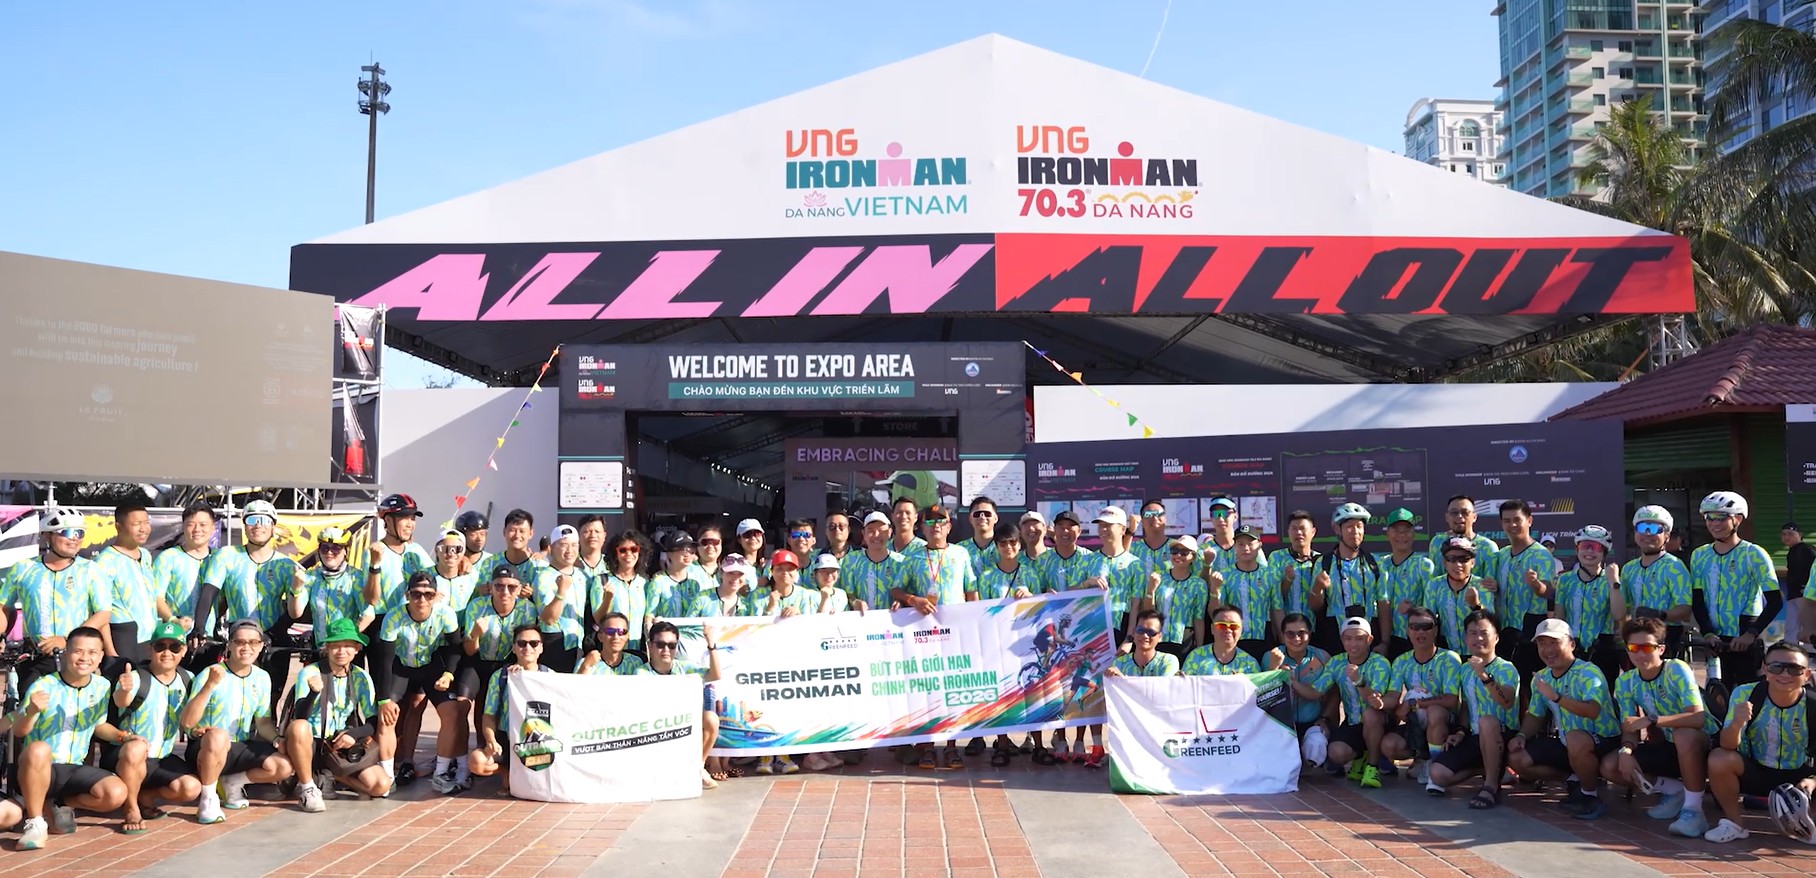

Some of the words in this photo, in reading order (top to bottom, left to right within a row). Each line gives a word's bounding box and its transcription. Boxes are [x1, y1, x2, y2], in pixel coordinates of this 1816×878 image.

[786, 128, 858, 158] VNG
[1017, 125, 1089, 154] VNG
[786, 142, 967, 189] IRONMAN
[1017, 141, 1198, 187] IRONMAN
[785, 208, 803, 218] DA
[807, 207, 845, 218] NANG
[844, 195, 967, 216] VIETNAM
[1017, 188, 1087, 218] 70.3
[1093, 204, 1123, 218] DA
[1130, 204, 1193, 219] NANG
[335, 250, 724, 321] ALL
[740, 243, 995, 317] IN
[996, 245, 1336, 314] ALL
[1337, 246, 1674, 315] OUT
[73, 320, 98, 333] 2000
[100, 324, 136, 337] farmers
[136, 340, 178, 357] journey
[579, 355, 594, 363] VNG
[64, 350, 130, 367] sustainable
[133, 357, 193, 373] agriculture
[668, 355, 768, 379] WELCOME
[774, 355, 799, 378] TO
[805, 354, 855, 378] EXPO
[861, 354, 915, 377] AREA
[683, 384, 713, 396] CHÀO
[715, 384, 747, 396] MỪNG
[749, 386, 771, 398] BẠN
[773, 383, 795, 396] ĐẾN
[797, 386, 819, 396] KHU
[820, 385, 843, 398] VỰC
[845, 383, 875, 395] TRIỂN
[877, 383, 900, 395] LÃM
[797, 447, 899, 462] EMBRACING
[1484, 477, 1501, 486] VNG
[866, 630, 904, 640] IRONMAN
[913, 626, 951, 638] IRONMAN
[820, 641, 859, 651] GREENFEED
[735, 666, 860, 685] GREENFEED
[869, 660, 891, 677] BỨT
[895, 655, 919, 675] PHÁ
[921, 653, 944, 673] GIỚI
[947, 654, 971, 673] HẠN
[760, 683, 862, 701] IRONMAN
[871, 680, 906, 696] CHINH
[909, 676, 941, 695] PHỤC
[943, 671, 997, 690] IRONMAN
[947, 689, 996, 706] 2026
[571, 720, 649, 743] OUTRACE
[574, 746, 595, 754] VƯỢT
[596, 743, 611, 751] BẢN
[612, 740, 632, 748] THÂN
[637, 735, 658, 744] NÂNG
[674, 728, 689, 737] VÓC
[1162, 738, 1241, 759] GREENFEED
